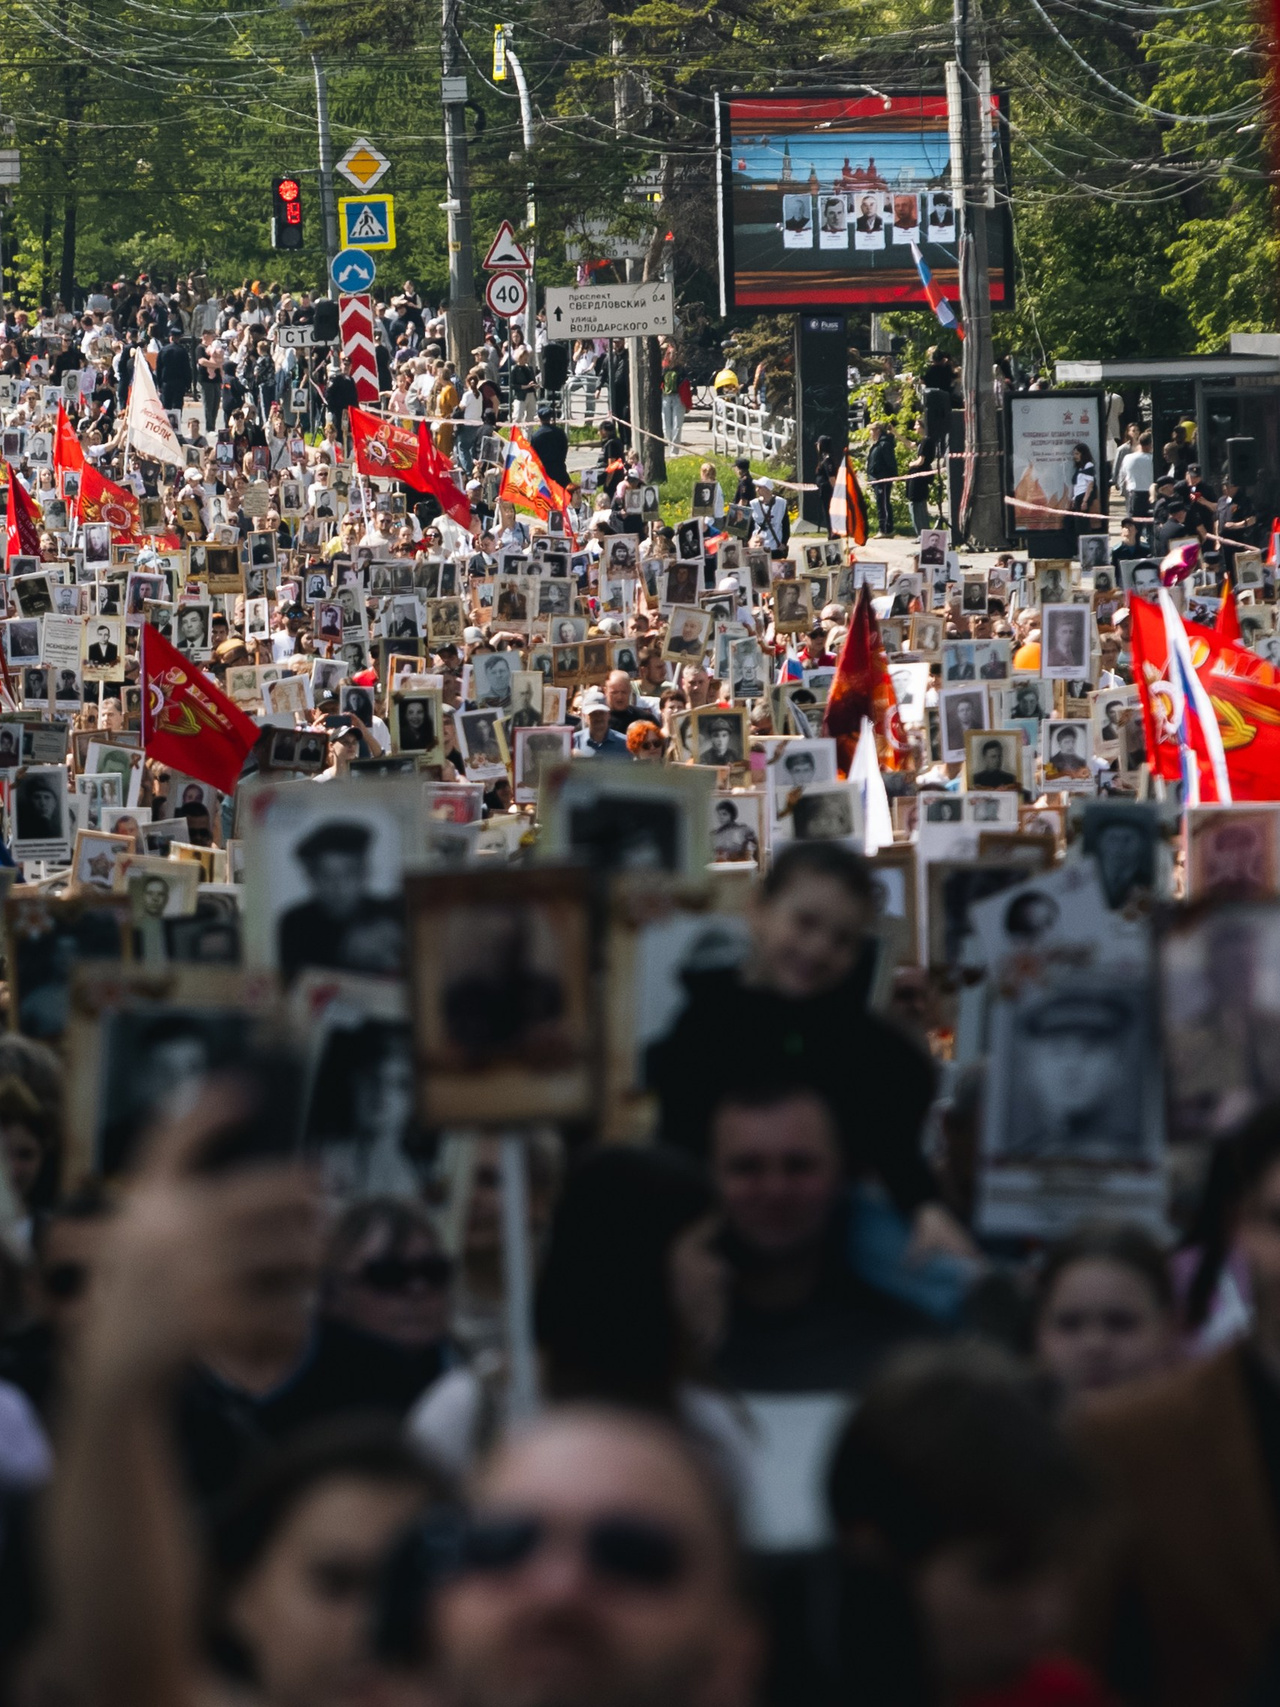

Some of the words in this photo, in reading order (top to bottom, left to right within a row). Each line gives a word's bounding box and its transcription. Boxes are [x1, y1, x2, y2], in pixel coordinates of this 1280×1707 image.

[496, 285, 519, 304] 40
[569, 293, 611, 301] проспект
[569, 299, 647, 310] СВЕРДЛОВСКИЙ
[570, 322, 648, 333] ВОЛОДАРСКОГО
[285, 330, 319, 344] СТО
[145, 421, 171, 441] ПОЛК
[166, 666, 188, 685] 9
